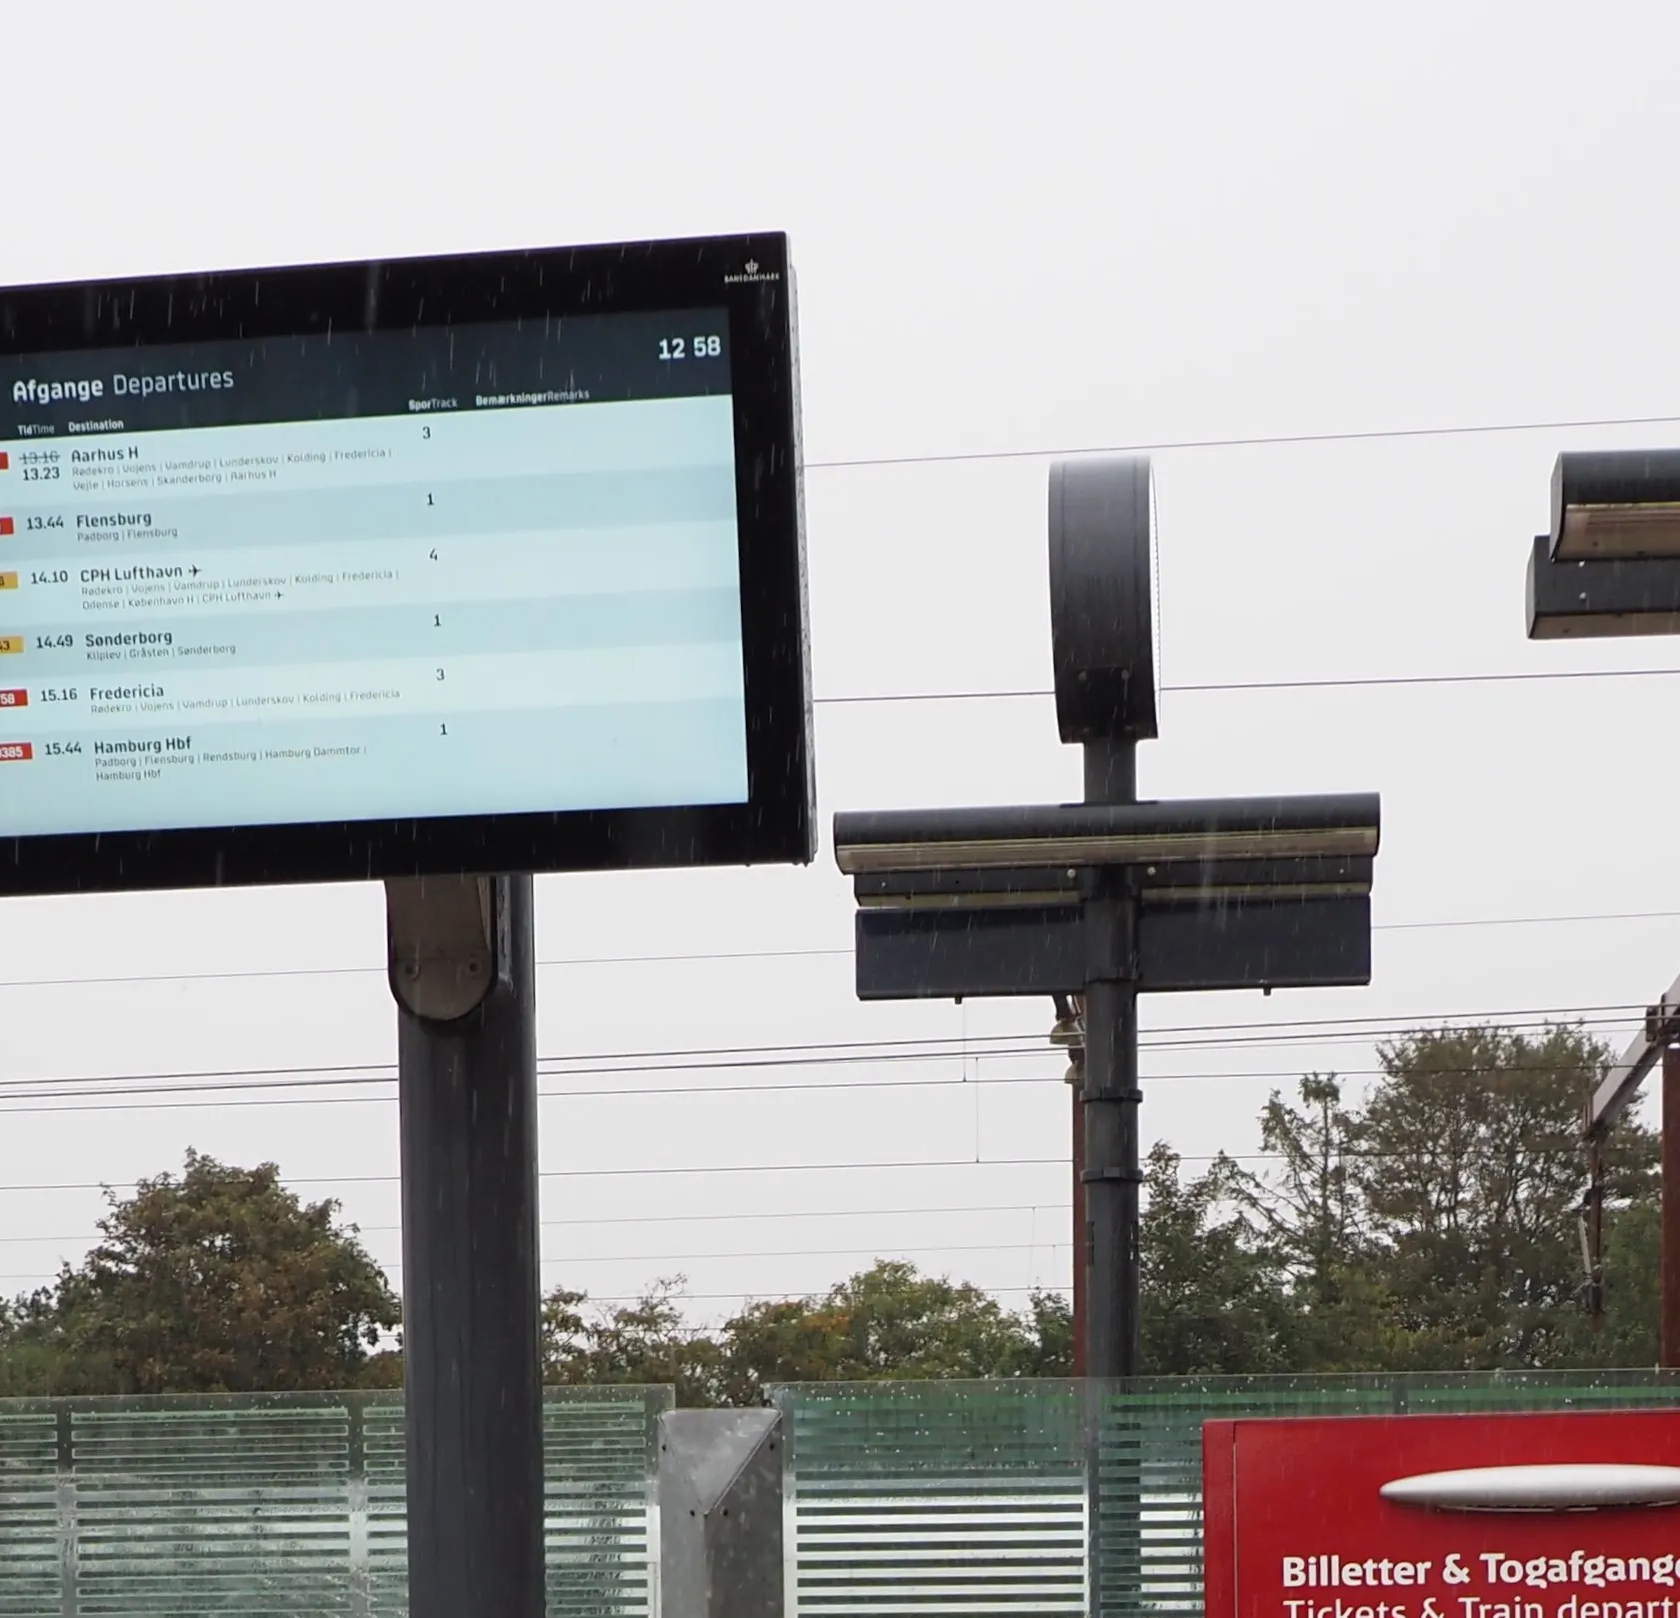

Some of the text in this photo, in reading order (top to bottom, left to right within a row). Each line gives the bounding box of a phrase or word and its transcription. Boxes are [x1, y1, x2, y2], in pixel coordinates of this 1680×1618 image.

[659, 335, 721, 360] 12 58
[13, 369, 234, 404] Afgange Departures
[69, 419, 124, 432] Destination
[72, 449, 124, 463] Aarhus
[129, 446, 138, 458] H
[423, 427, 431, 439] 3
[23, 467, 60, 481] 13.23
[27, 516, 64, 530] 13.44
[77, 513, 151, 528] Flensburg
[427, 493, 435, 505] 1
[78, 527, 177, 542] Padborg Flensburg
[31, 570, 68, 584] 14.10
[80, 568, 110, 582] CPH
[115, 564, 183, 581] Lufthavn
[430, 549, 438, 560] 4
[36, 634, 73, 648] 14.49
[85, 632, 173, 648] Sønderborg
[433, 615, 441, 626] 1
[41, 688, 77, 702] 15.16
[90, 684, 164, 700] Fredericia
[437, 668, 445, 680] 3
[45, 742, 83, 756] 15.44
[94, 738, 161, 754] Hamburg
[166, 736, 191, 750] Hbf
[441, 724, 447, 736] 1
[95, 756, 137, 768] Padborg
[203, 751, 257, 763] Rendsburg
[265, 748, 311, 760] Hamburg
[97, 769, 161, 782] Hamburg Hbf
[1283, 1555, 1431, 1587] Billetter
[1443, 1553, 1471, 1584] &
